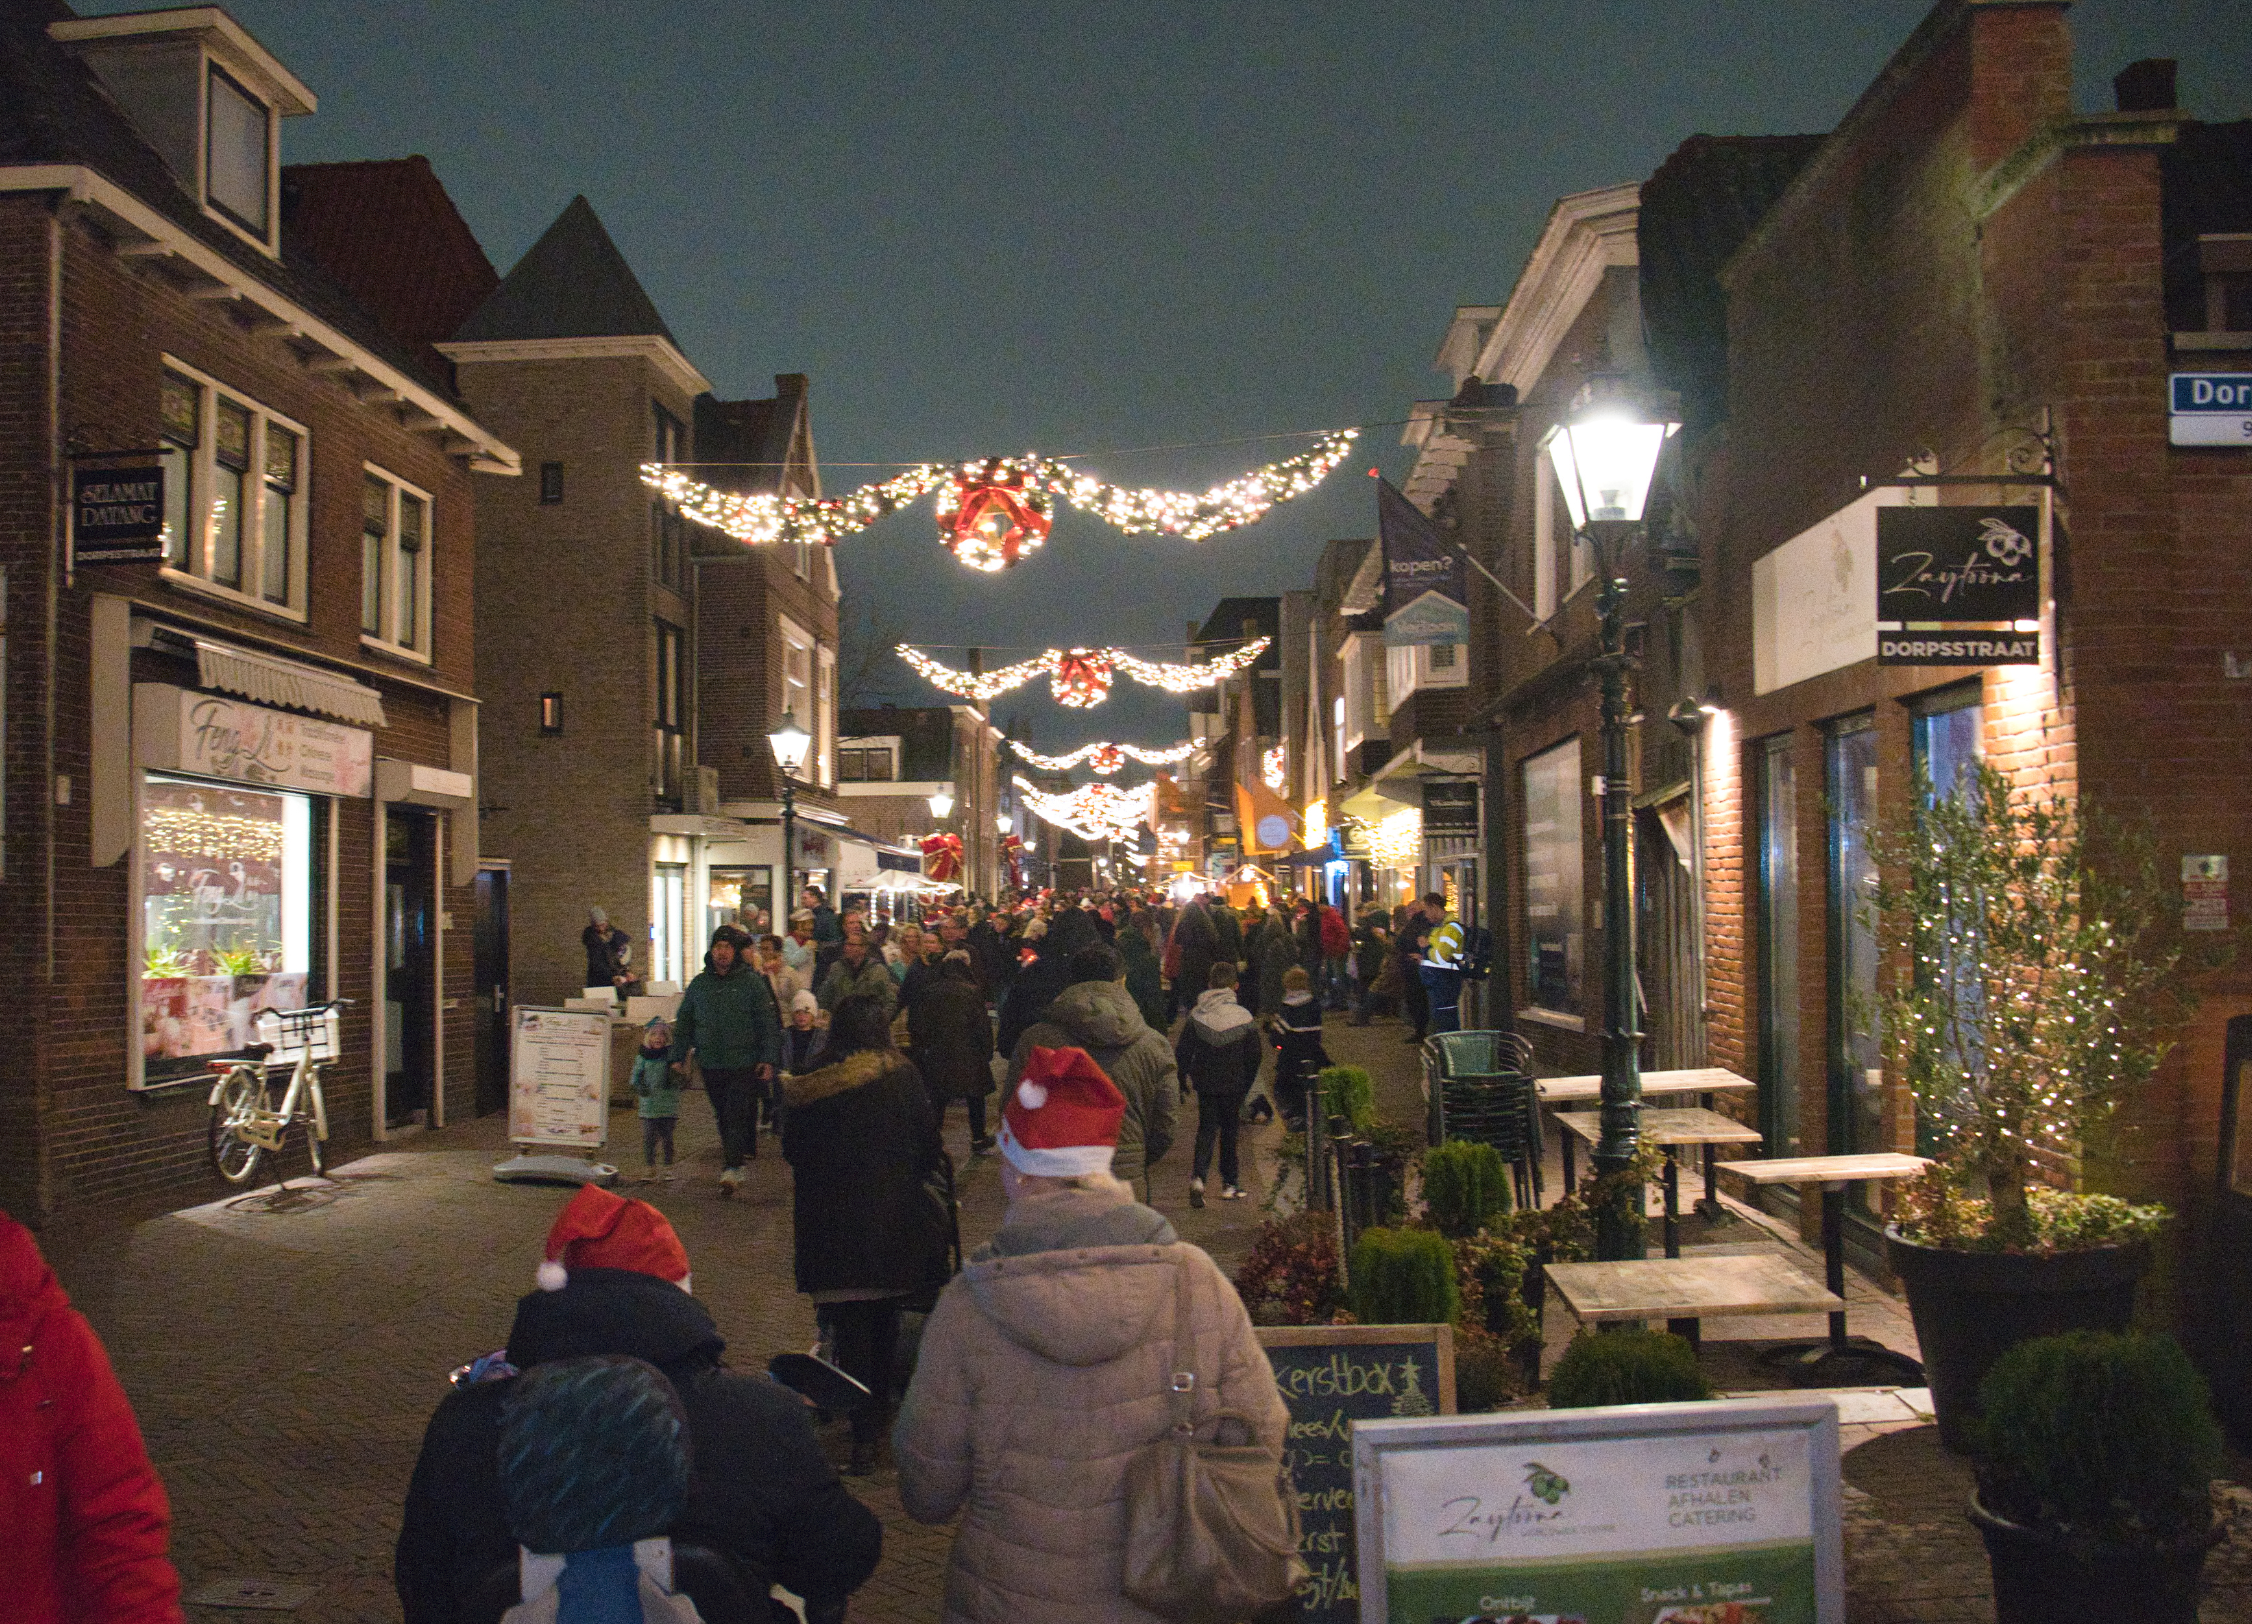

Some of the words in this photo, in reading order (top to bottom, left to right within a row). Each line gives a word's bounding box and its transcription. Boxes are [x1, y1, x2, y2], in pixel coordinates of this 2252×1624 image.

[2193, 380, 2252, 404] Dor
[80, 482, 159, 503] SELAMAT
[81, 504, 158, 527] DATANG
[1389, 556, 1453, 576] kopen?
[1881, 641, 2036, 657] DORPSSTRAAT
[1665, 1467, 1781, 1490] RESTAURANT
[1668, 1488, 1751, 1507] AFHALEN
[1668, 1507, 1756, 1528] CATERING
[1641, 1587, 1688, 1603] Snack
